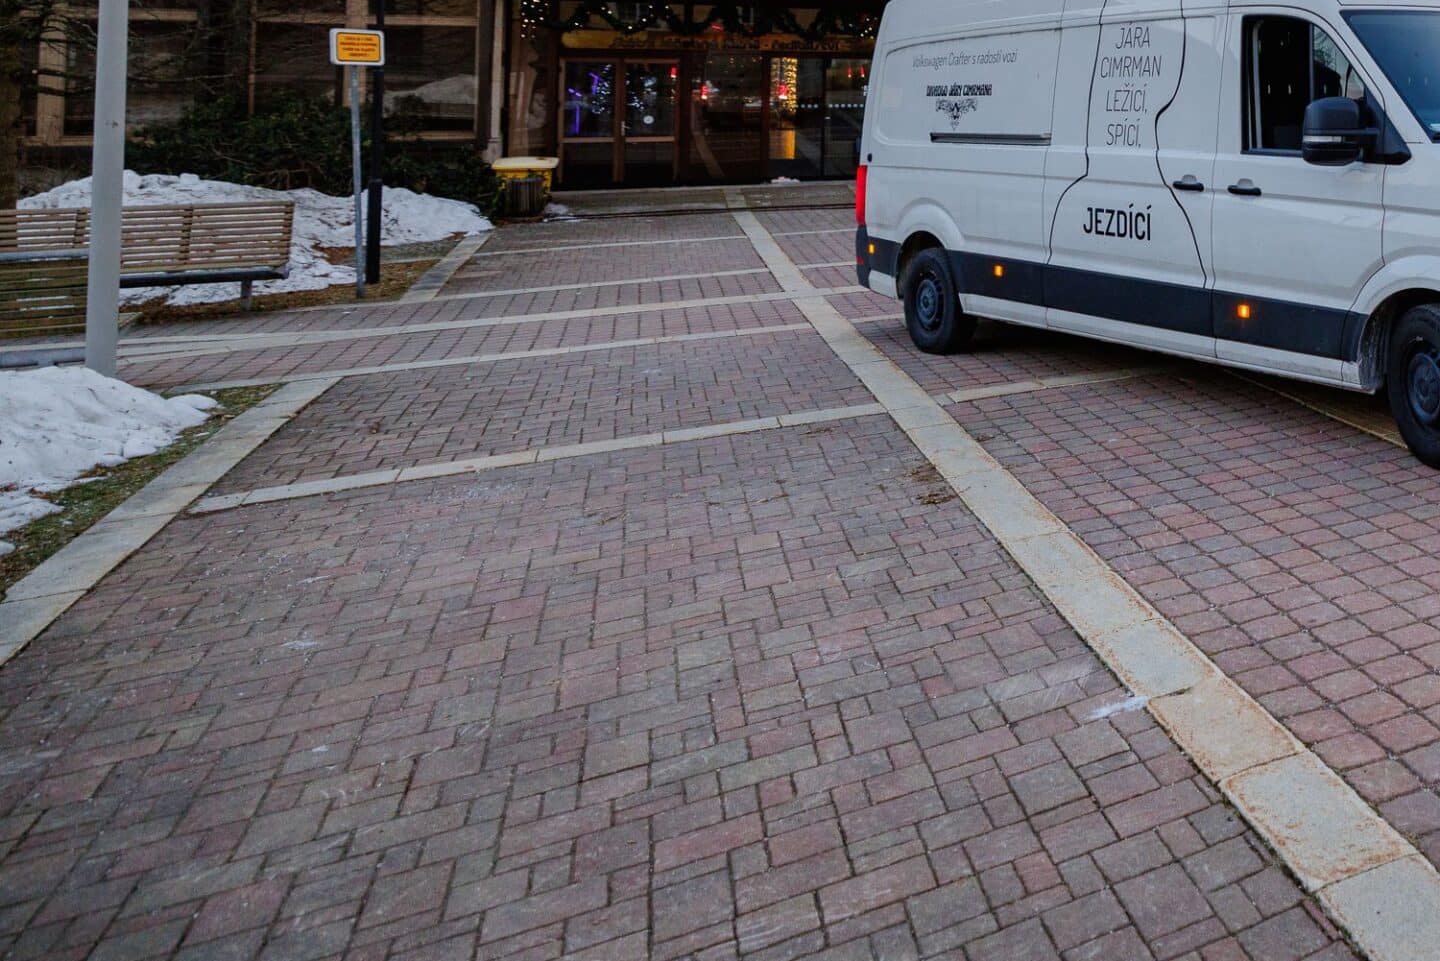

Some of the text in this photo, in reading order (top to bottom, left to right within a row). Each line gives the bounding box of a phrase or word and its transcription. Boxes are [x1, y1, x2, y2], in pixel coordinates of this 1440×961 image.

[1115, 20, 1150, 49] JÁRA
[912, 54, 948, 71] Volkswagen
[949, 50, 971, 66] Crafter
[1100, 55, 1162, 78] CIMRMAN
[1105, 82, 1147, 114] LEŽÍCÍ,
[1106, 118, 1142, 148] SPÍCÍ,
[1083, 203, 1152, 241] JEZDÍCÍ
